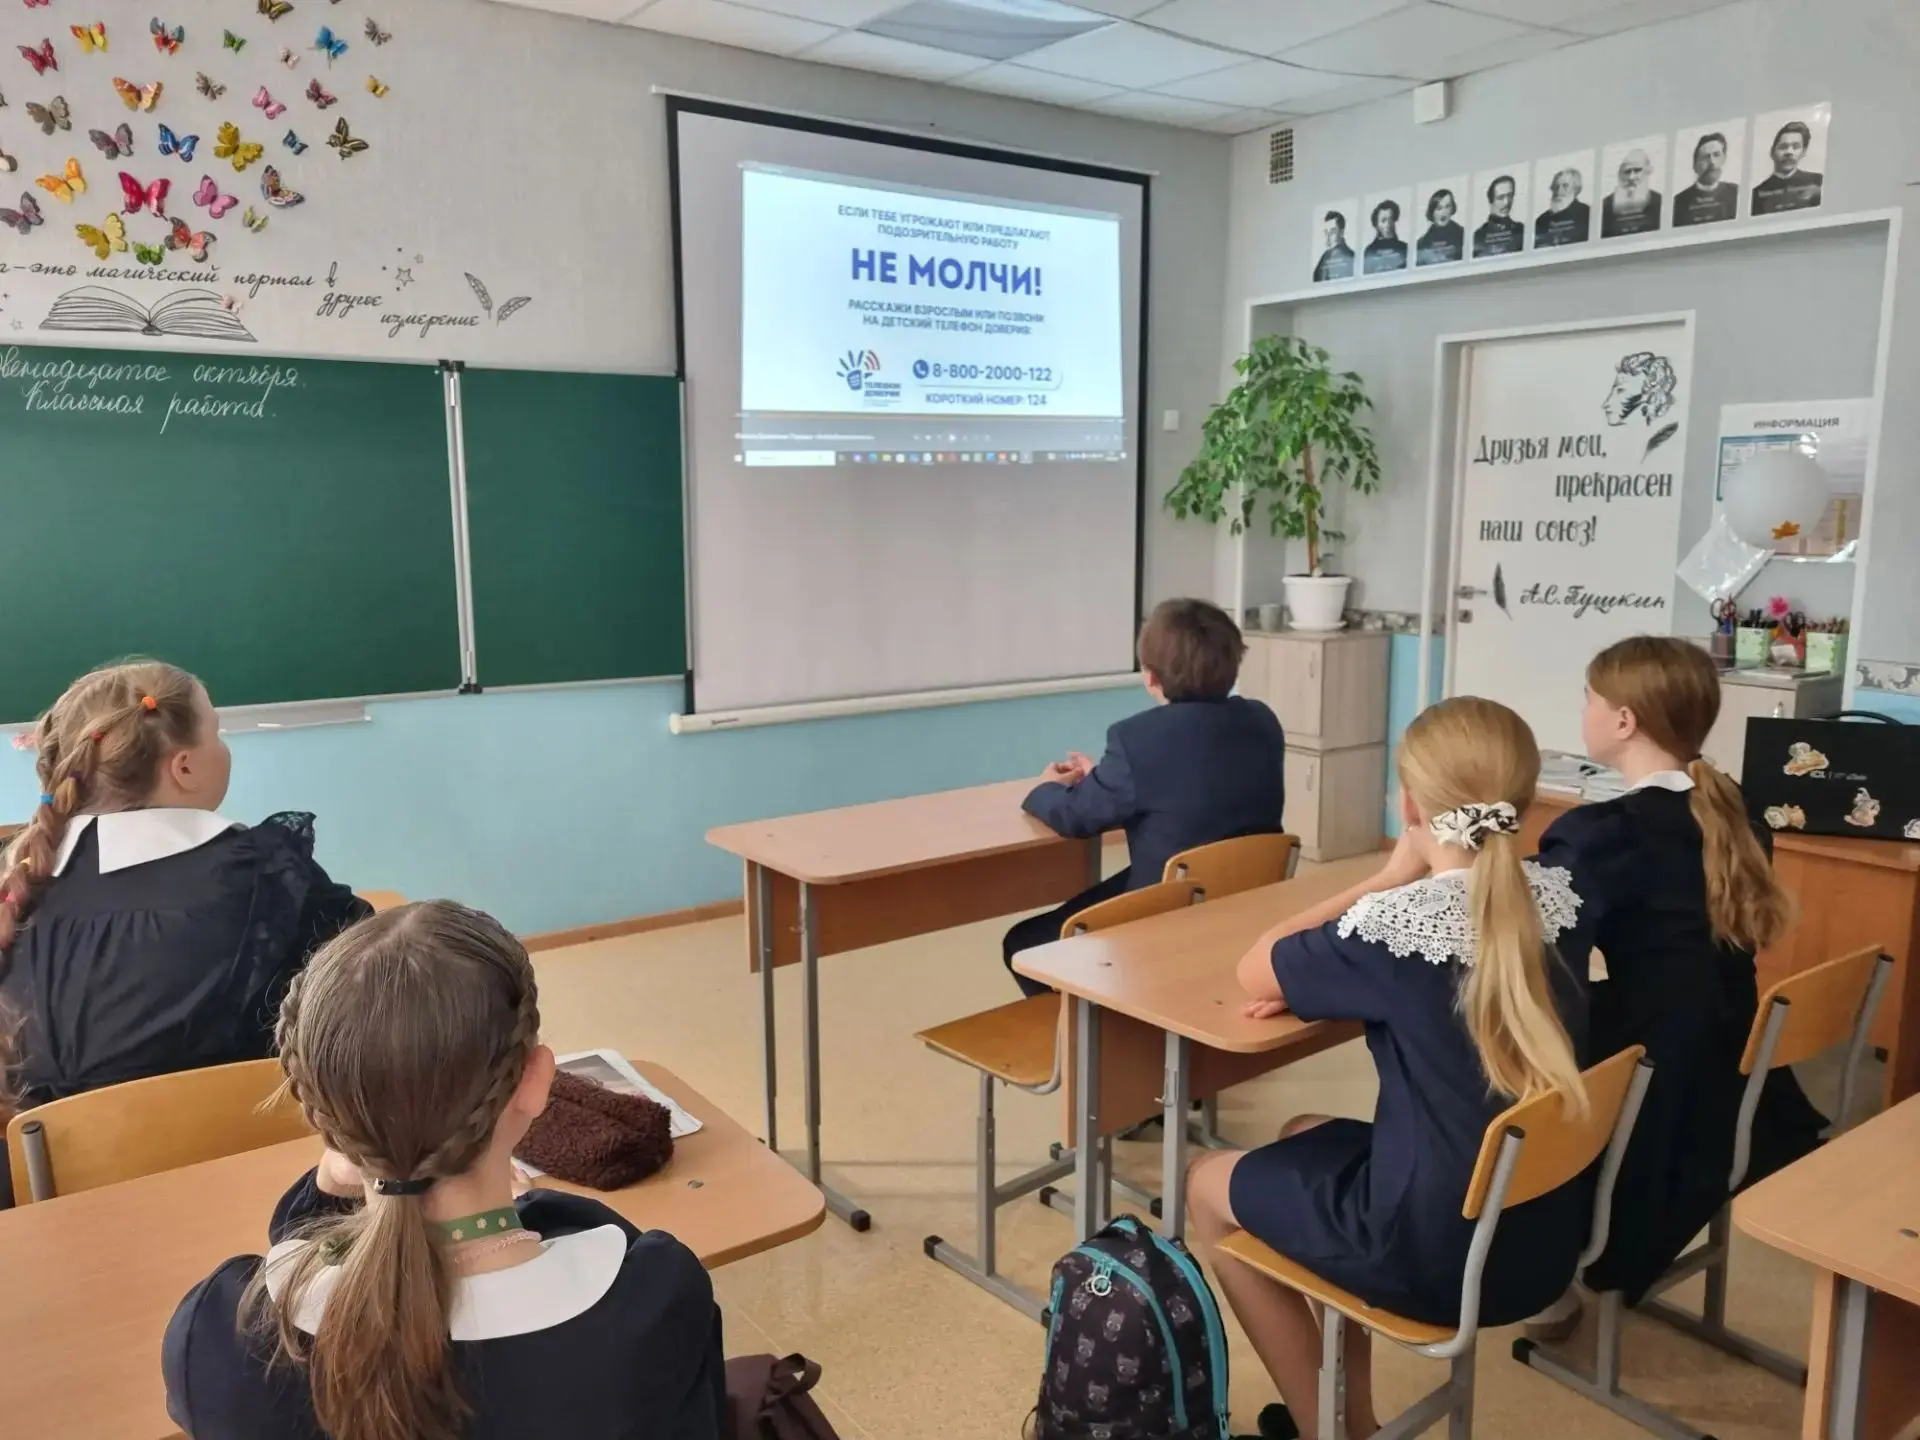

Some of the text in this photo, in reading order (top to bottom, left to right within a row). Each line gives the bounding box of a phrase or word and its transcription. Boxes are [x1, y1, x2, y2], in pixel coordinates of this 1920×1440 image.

[838, 204, 868, 217] ЕСЛИ
[871, 208, 897, 221] ТЕБЕ
[981, 236, 1019, 249] РАБОТУ
[86, 264, 220, 283] магический
[232, 271, 316, 299] портал
[852, 247, 1042, 296] НЕ МОЛЧИ!
[316, 291, 384, 317] другое
[848, 299, 912, 313] РАССКАЖИ
[914, 304, 973, 318] ВЗРОСЛЫМ
[379, 311, 481, 339] измерение
[862, 314, 878, 325] НА
[880, 315, 932, 329] ДЕТСКИЙ
[935, 319, 983, 333] ТЕЛЕФОН
[932, 362, 1053, 382] 8-800-2000-122
[20, 379, 145, 414] Классная
[925, 392, 984, 404] КОРОТКИЙ
[1027, 393, 1048, 406] 124
[1753, 416, 1840, 429] ИНФОРМАЦИЯ
[1473, 434, 1549, 465] Друзья
[1554, 471, 1673, 503] прекрасен
[1479, 515, 1598, 548] наш союз!
